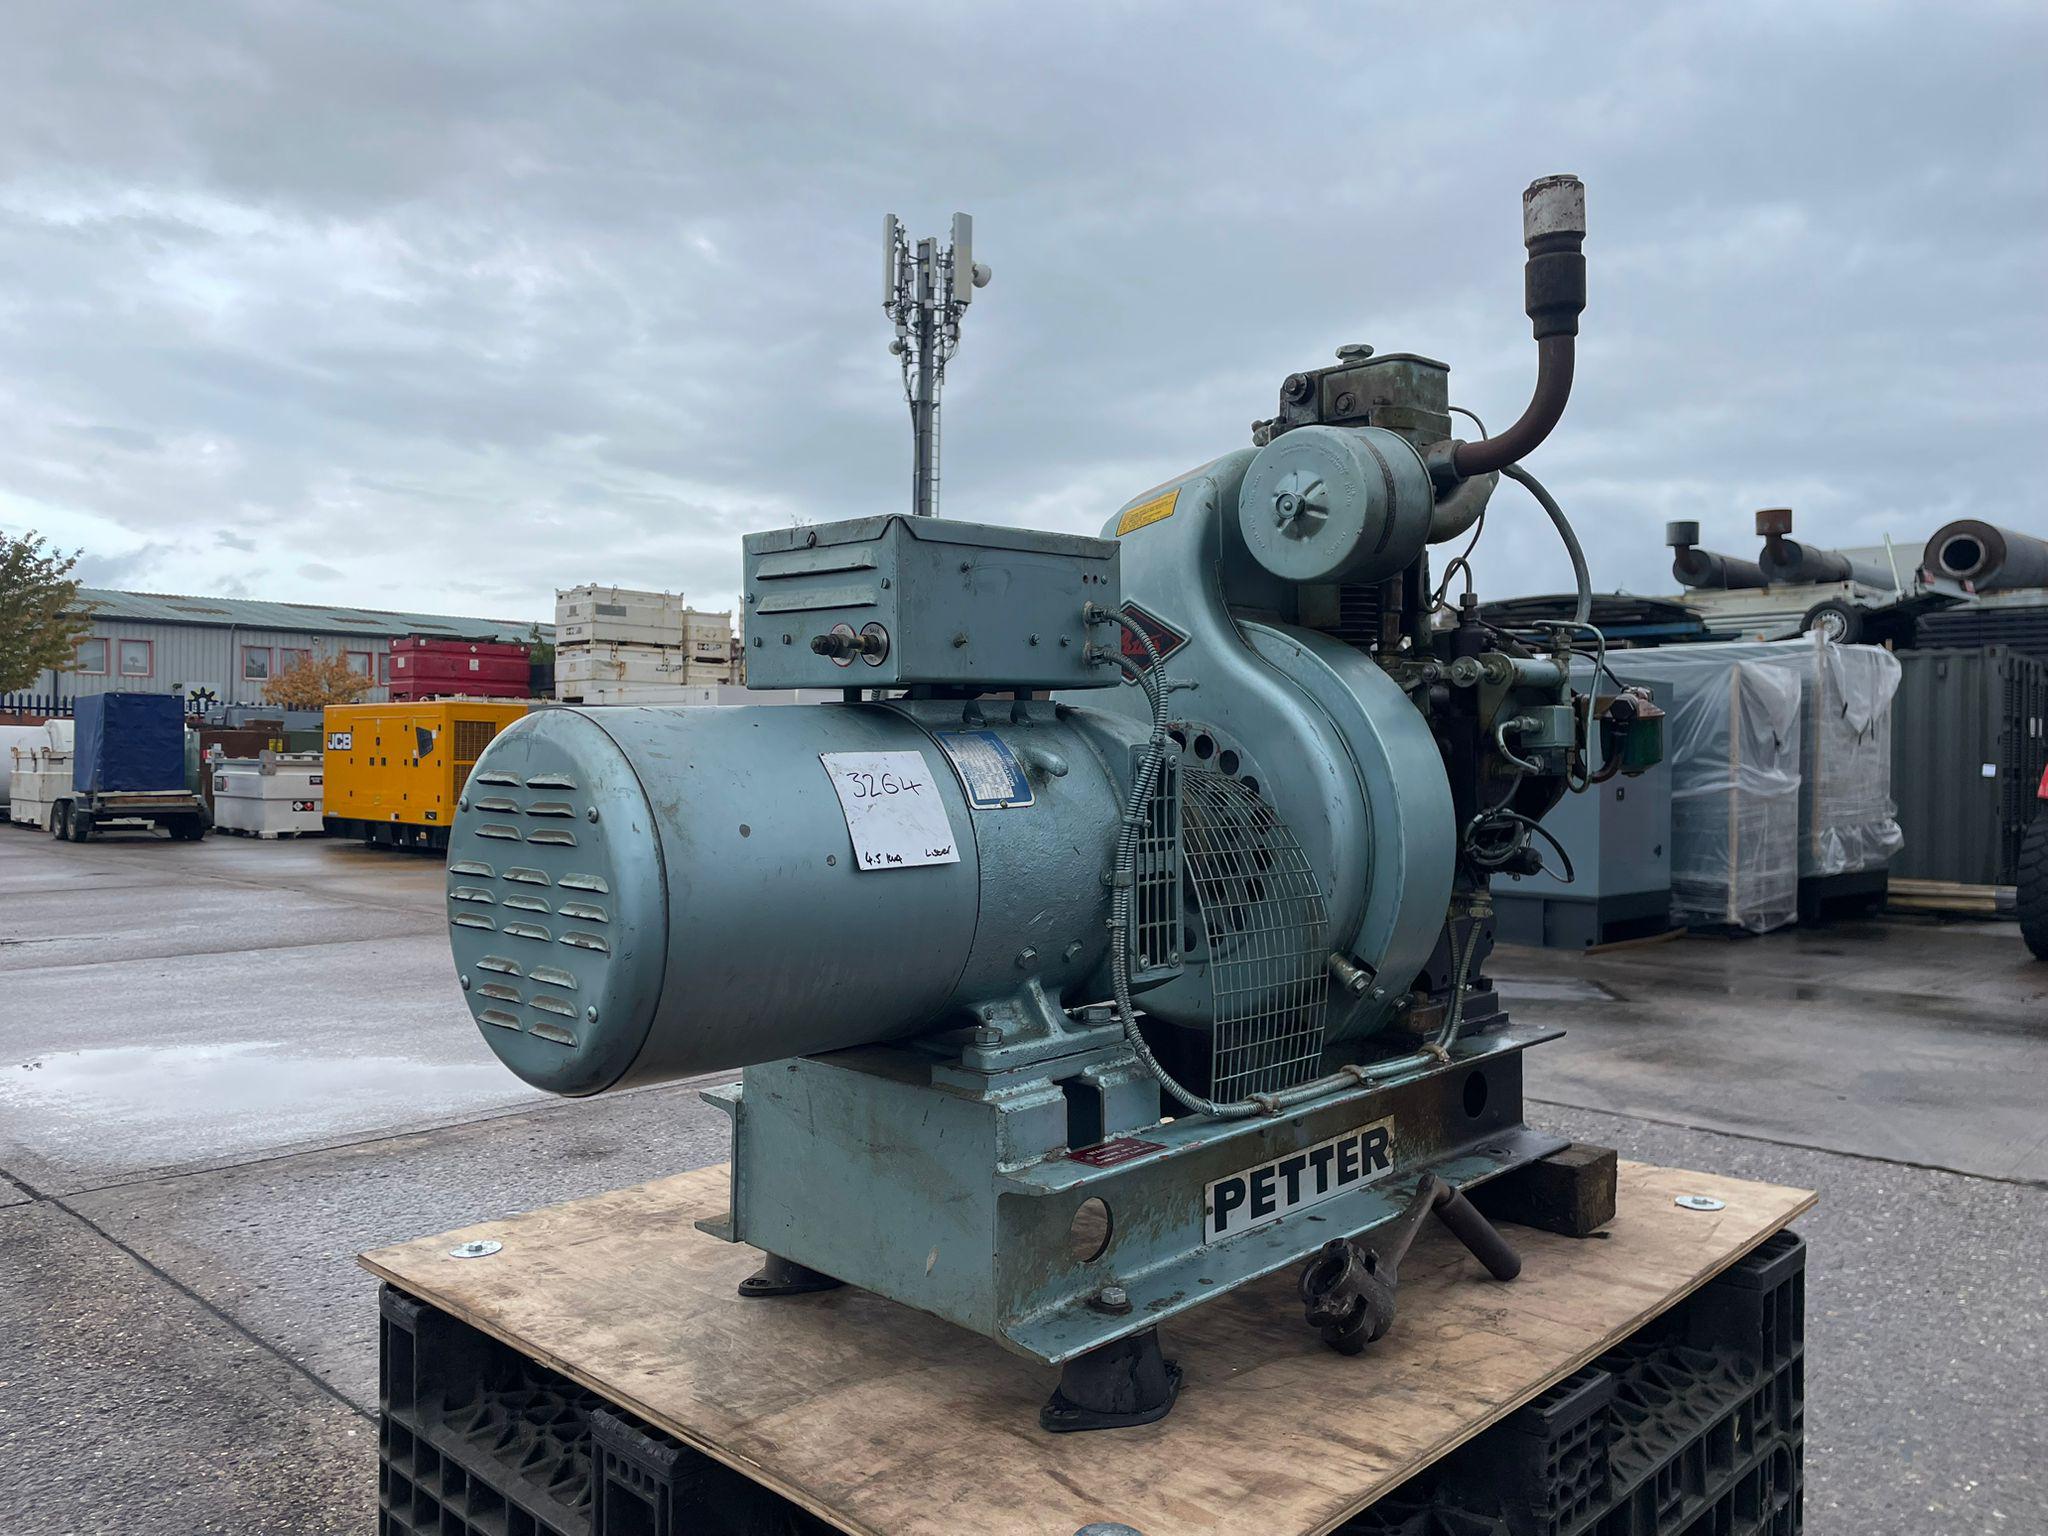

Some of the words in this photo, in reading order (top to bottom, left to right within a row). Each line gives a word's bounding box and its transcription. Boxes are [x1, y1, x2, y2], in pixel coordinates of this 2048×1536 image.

[327, 732, 352, 750] JCB
[846, 772, 922, 798] 3264
[865, 851, 881, 866] 4.5
[1214, 1126, 1390, 1234] PETTER
